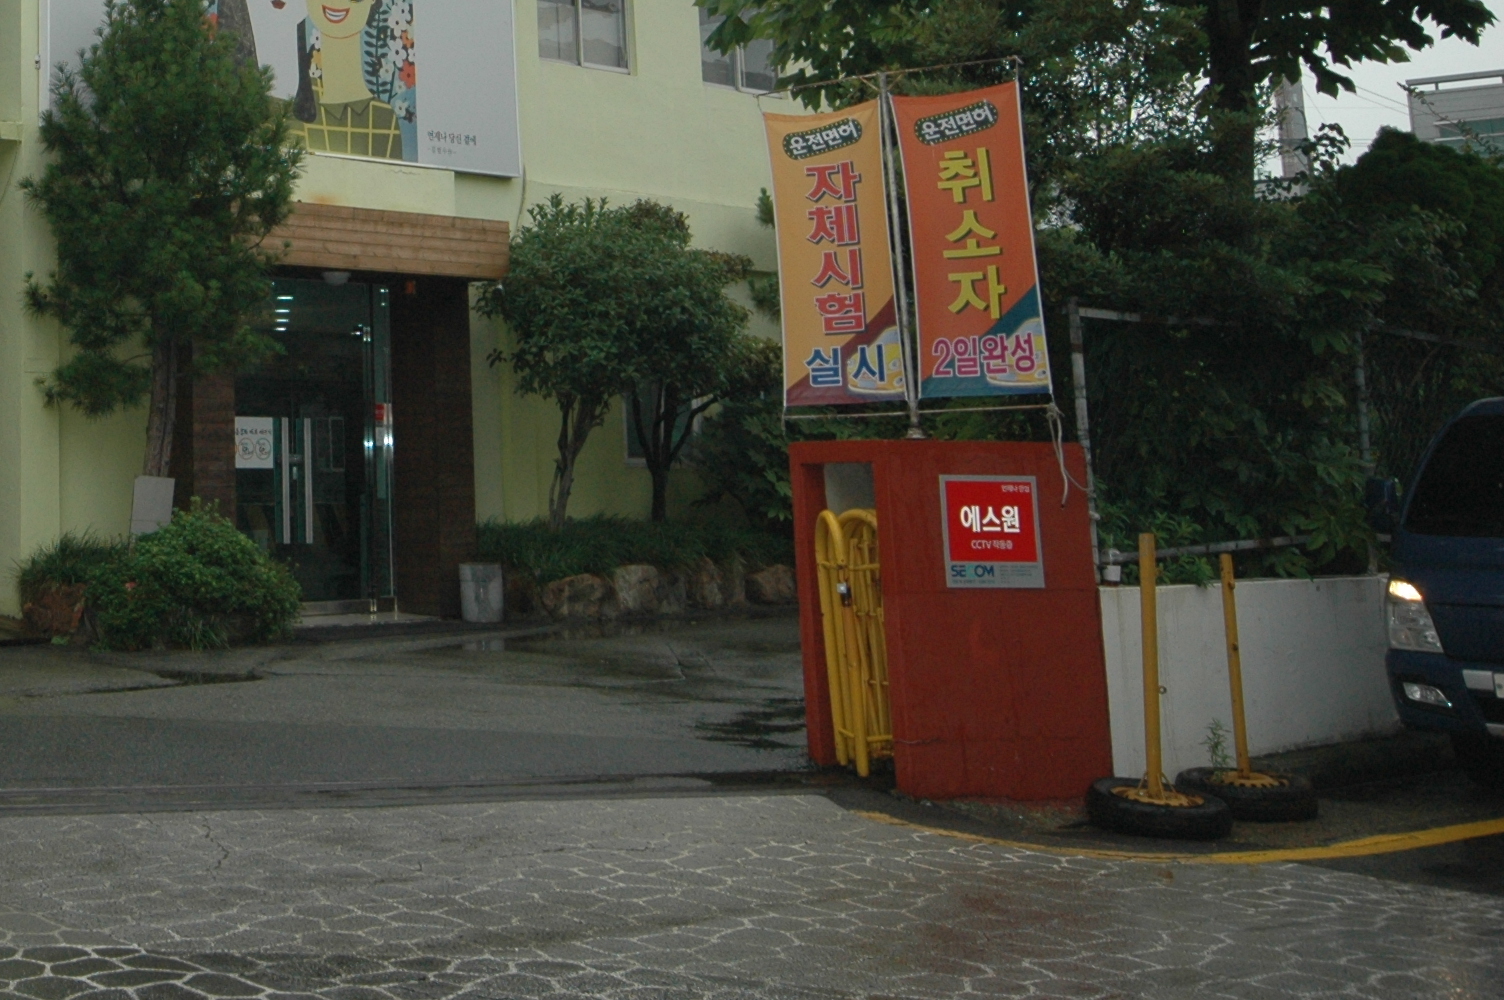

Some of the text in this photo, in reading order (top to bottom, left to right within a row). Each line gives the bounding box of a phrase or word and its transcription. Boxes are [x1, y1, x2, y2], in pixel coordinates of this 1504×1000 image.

[788, 118, 860, 155] 운전면허
[920, 103, 995, 141] 운전면허
[804, 160, 866, 335] 자체시험
[937, 146, 1006, 321] 취소자
[804, 343, 886, 388] 실시
[960, 505, 1020, 533] 에스원
[971, 539, 992, 550] CCTV
[950, 564, 995, 578] SECOM
